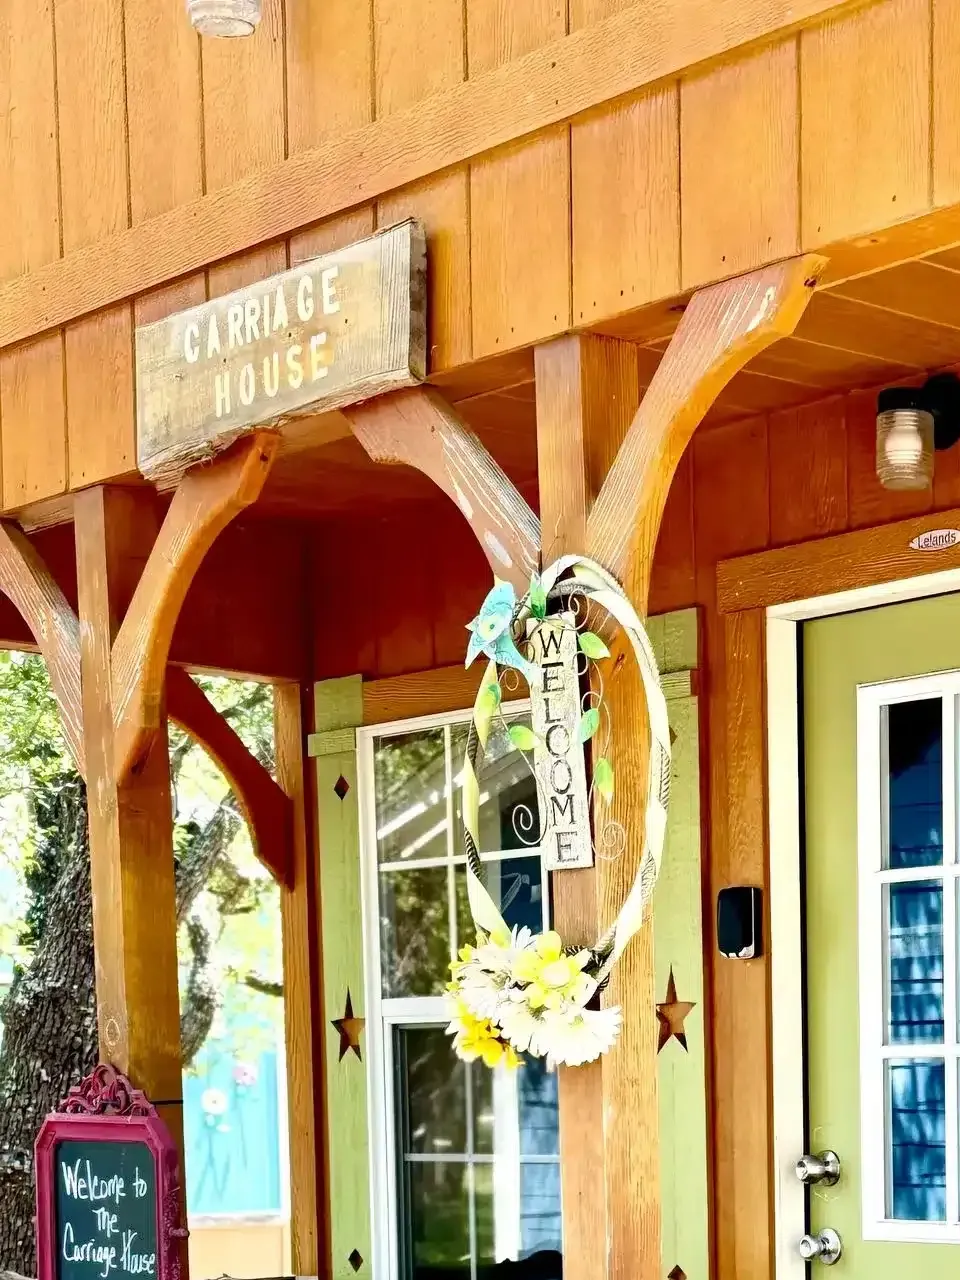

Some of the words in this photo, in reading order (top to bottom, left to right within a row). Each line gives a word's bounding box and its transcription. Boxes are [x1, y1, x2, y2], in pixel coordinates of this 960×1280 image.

[184, 266, 341, 363] CARRIAGE
[214, 332, 329, 418] HOUSE
[917, 530, 957, 549] Lelands
[538, 629, 580, 863] WELCOME
[61, 1158, 126, 1204] Welcome
[132, 1166, 148, 1198] to
[62, 1222, 118, 1278] Carriage
[119, 1229, 156, 1274] House
[91, 1206, 120, 1238] The
